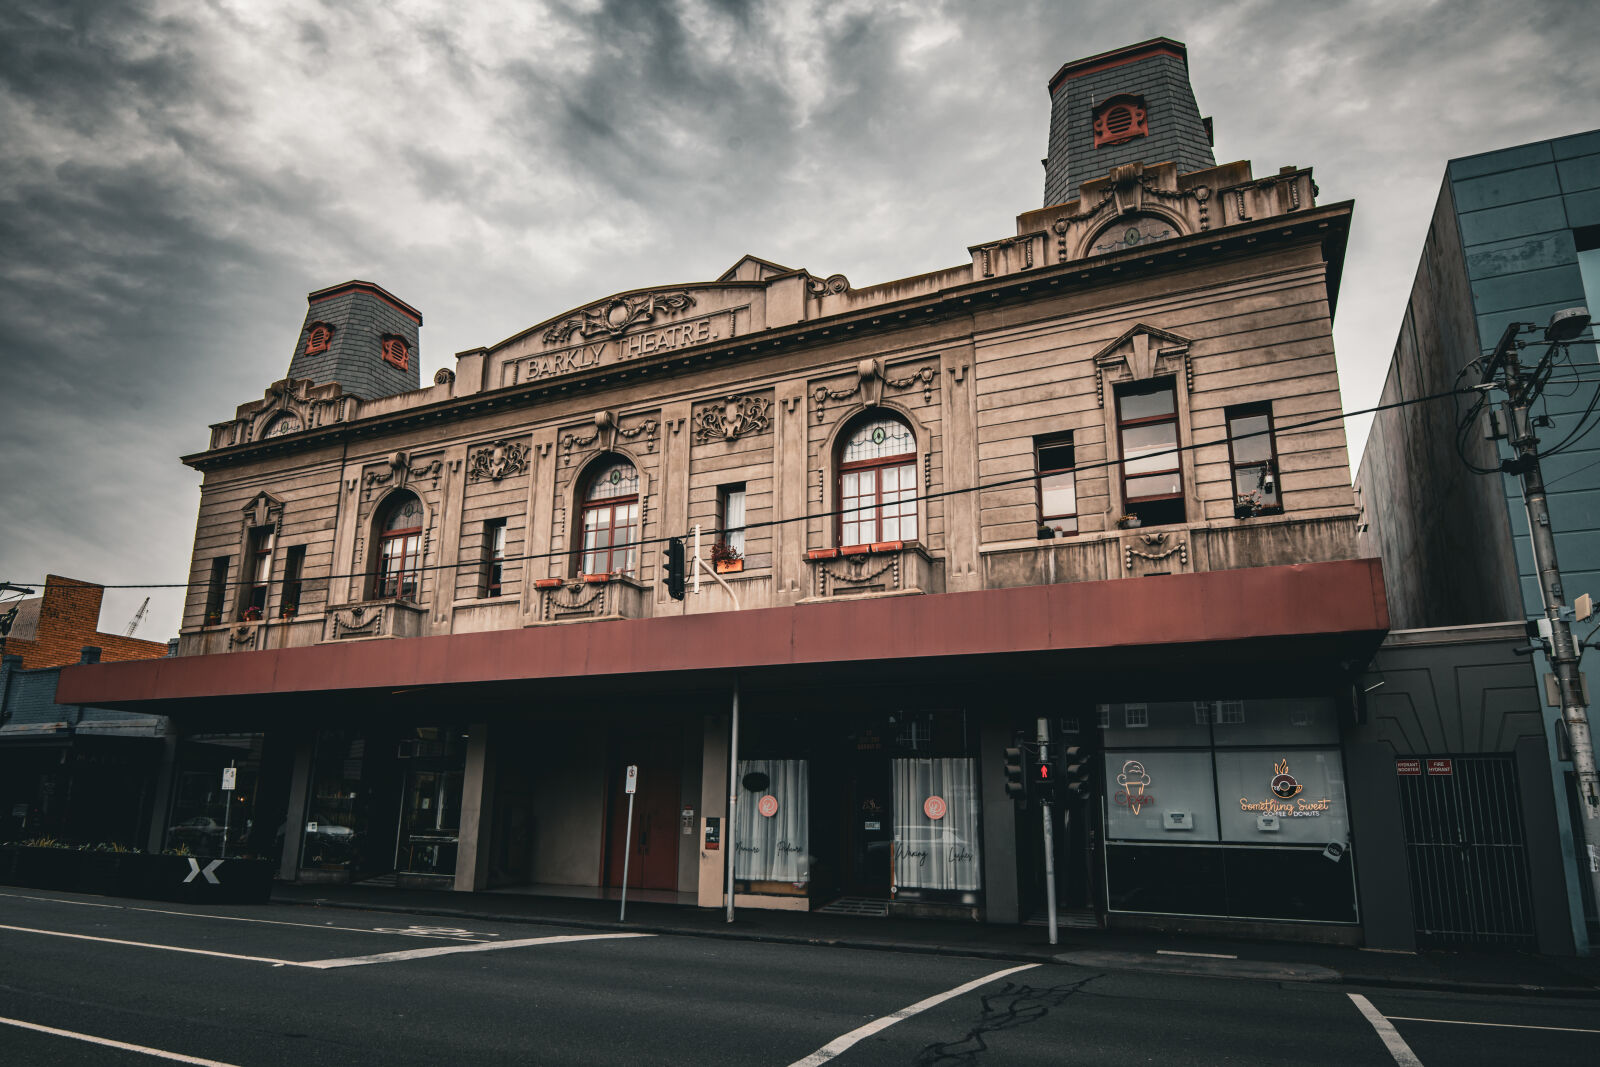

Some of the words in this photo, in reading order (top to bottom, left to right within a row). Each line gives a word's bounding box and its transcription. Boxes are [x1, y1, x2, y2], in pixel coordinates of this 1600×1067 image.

[526, 343, 606, 379] BARKLY
[1114, 790, 1154, 808] Open
[1239, 797, 1295, 816] Something
[1297, 797, 1331, 811] Sweet
